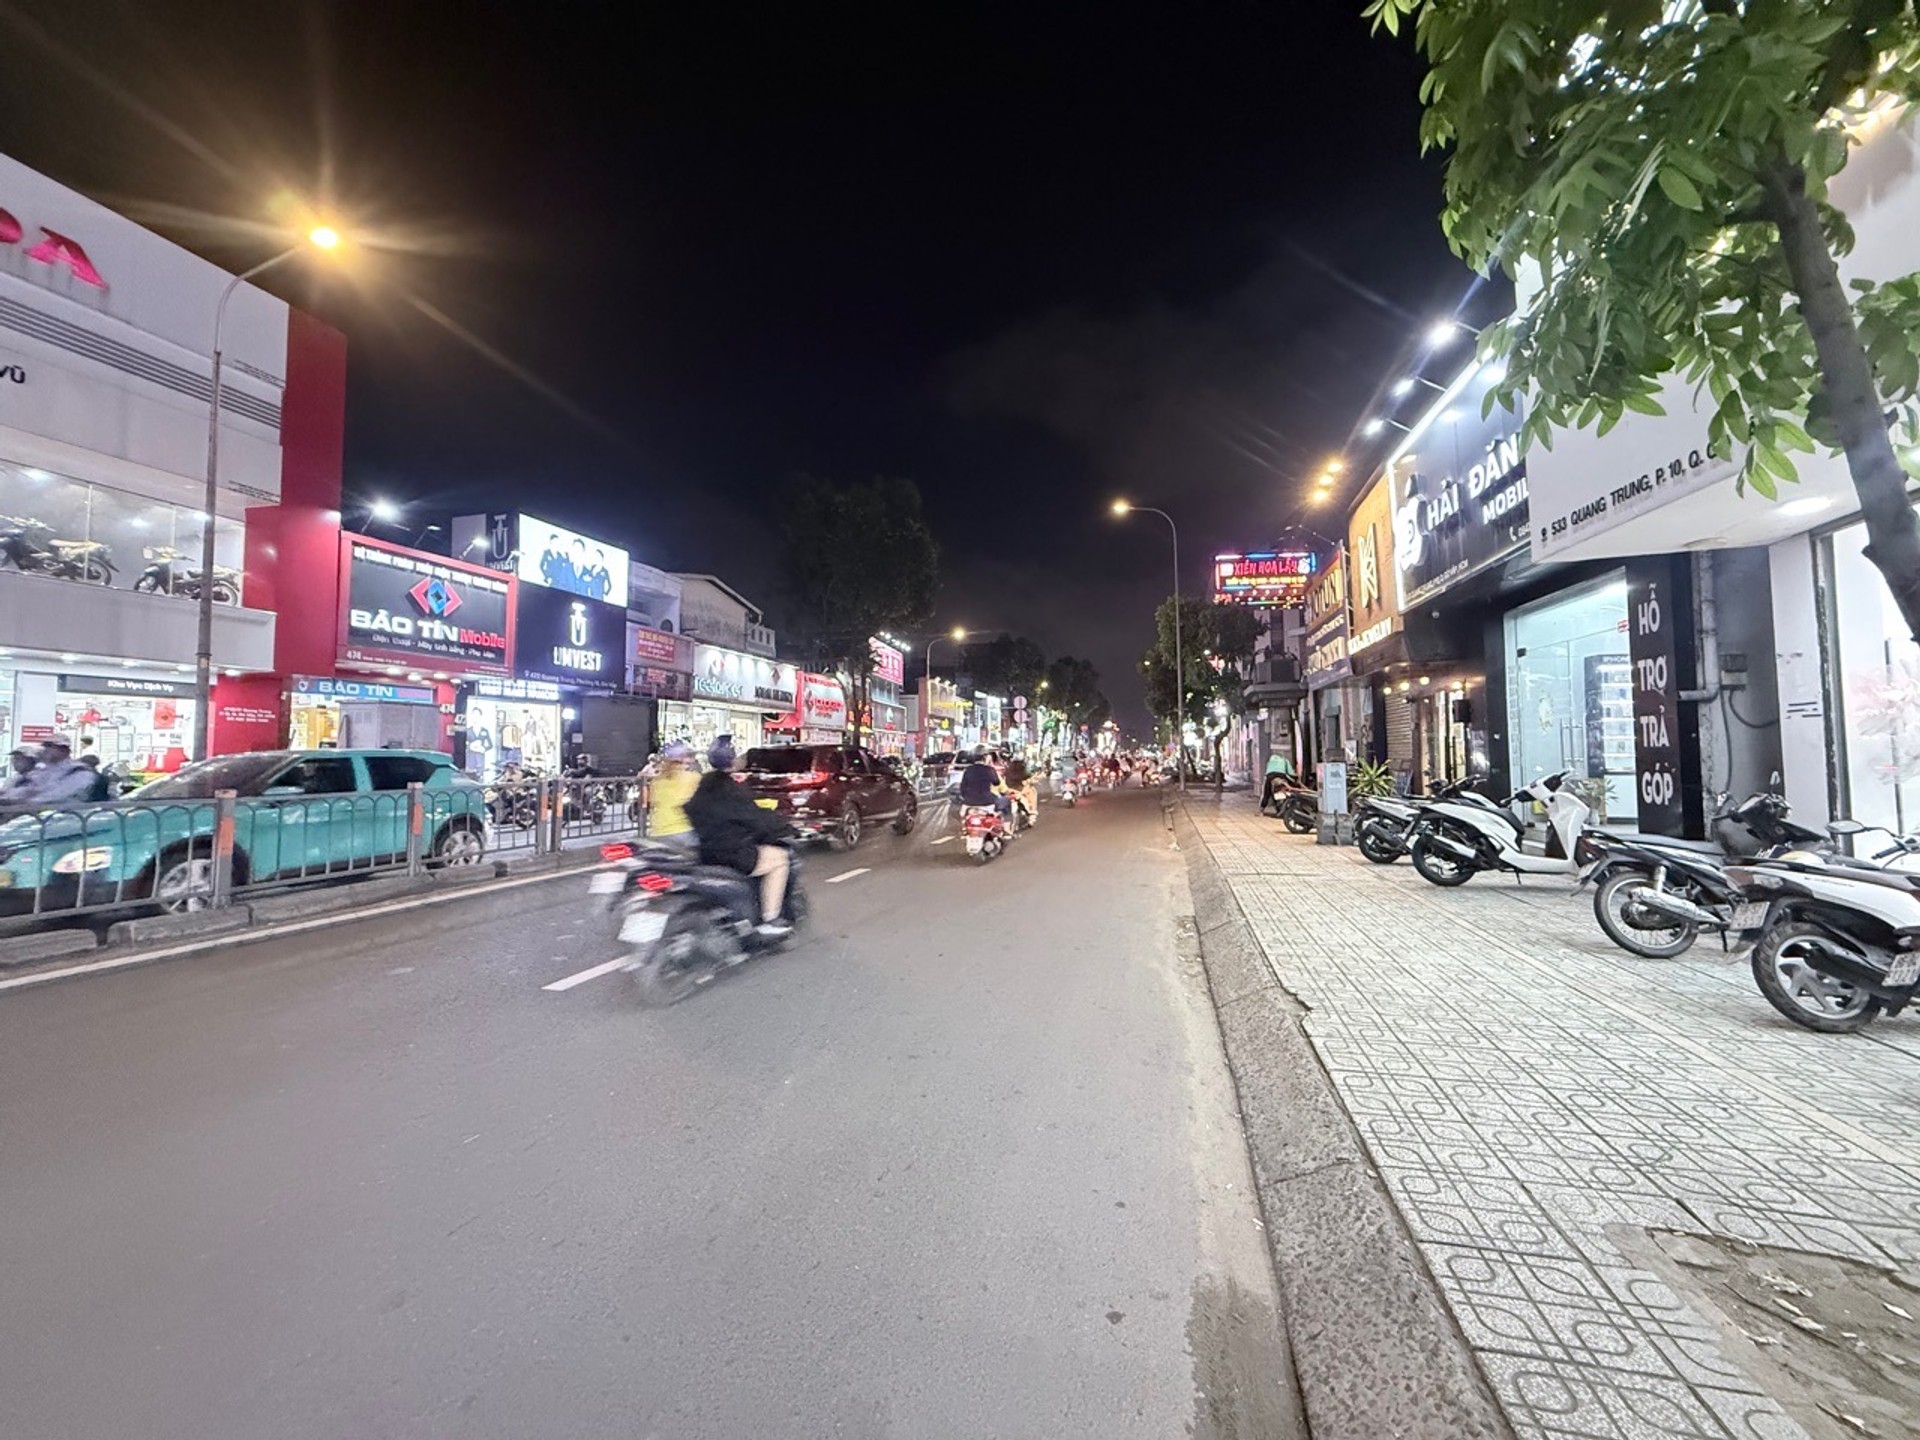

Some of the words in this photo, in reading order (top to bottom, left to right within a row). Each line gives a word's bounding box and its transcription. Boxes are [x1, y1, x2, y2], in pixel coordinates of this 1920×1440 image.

[1427, 480, 1460, 531] HẢI
[1468, 432, 1520, 499] ĐĂN
[1481, 477, 1530, 524] MOBIL
[1551, 516, 1567, 536] 533
[1570, 497, 1606, 526] QUANG
[1610, 474, 1653, 507] TRUNG,
[350, 609, 413, 635] BẢO
[417, 619, 458, 642] TÍN
[1638, 582, 1660, 636] HỖ
[1637, 655, 1668, 697] TRỢ
[1640, 704, 1669, 748] TRẢ
[1642, 763, 1673, 806] GÓP
